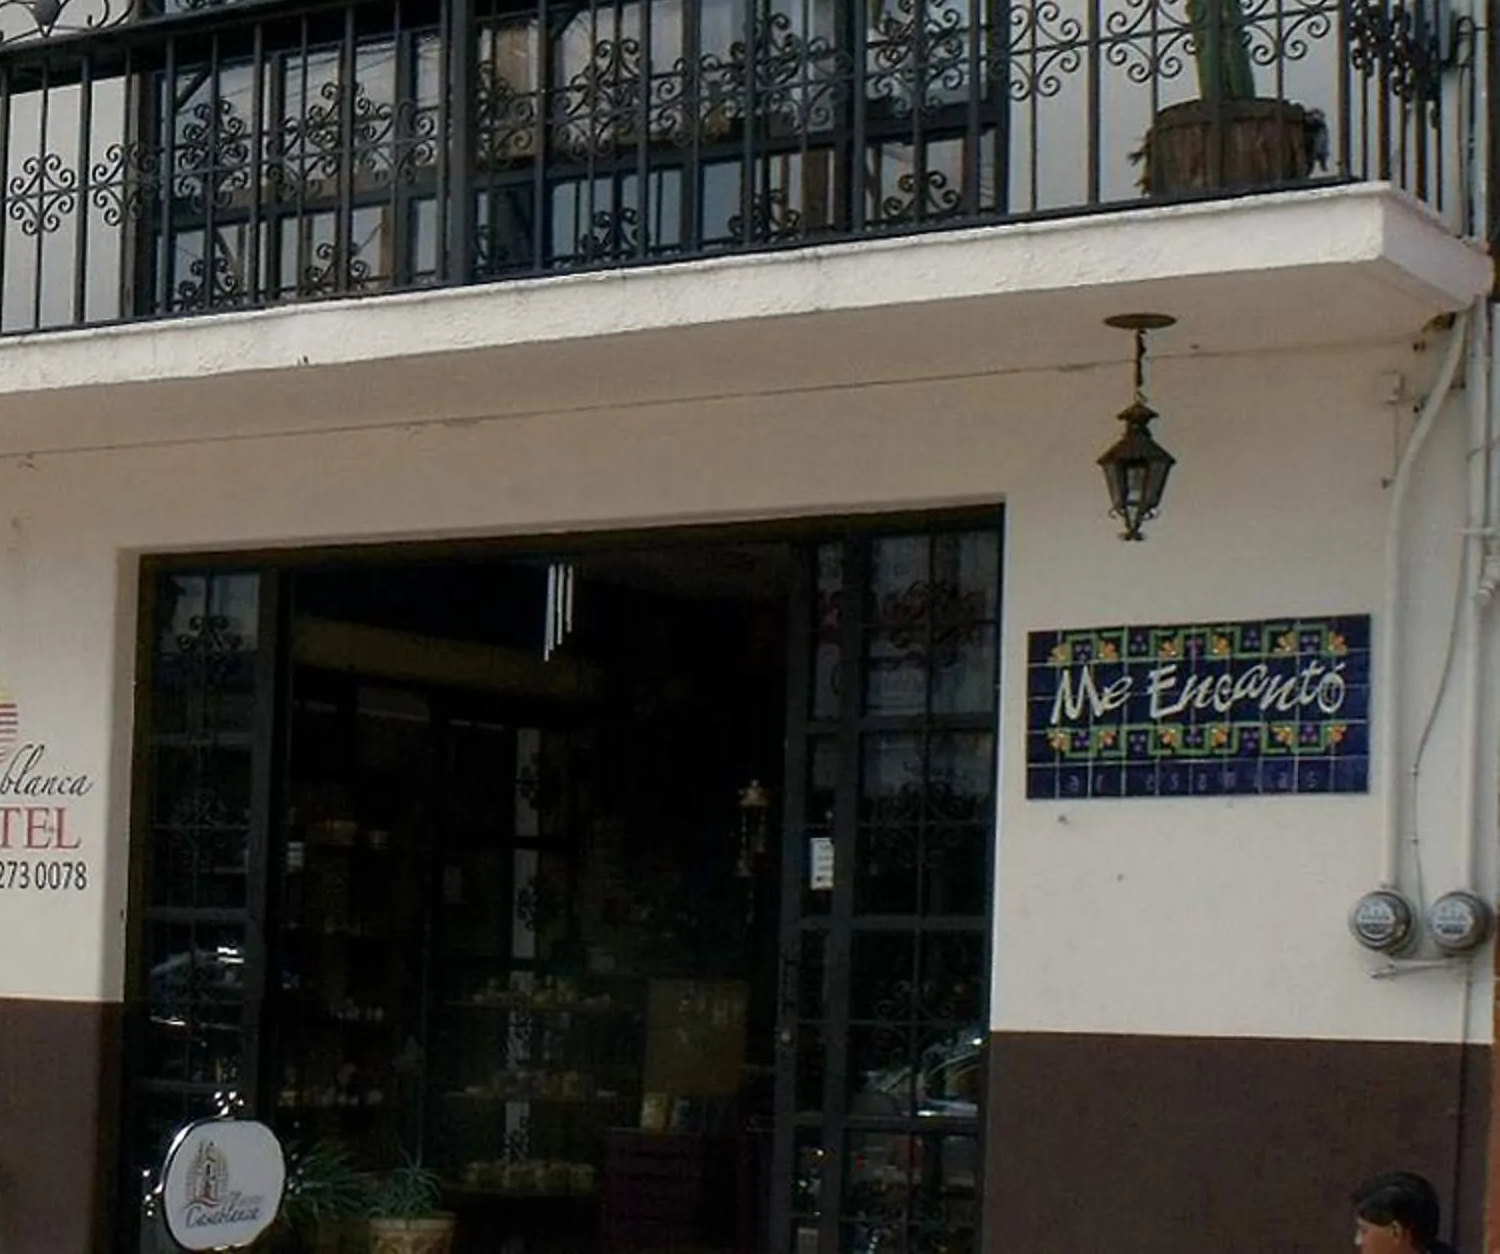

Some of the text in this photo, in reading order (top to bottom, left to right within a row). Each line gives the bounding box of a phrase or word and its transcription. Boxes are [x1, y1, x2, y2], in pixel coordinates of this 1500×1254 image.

[1050, 660, 1346, 725] Me Encantó
[35, 861, 88, 891] 0078
